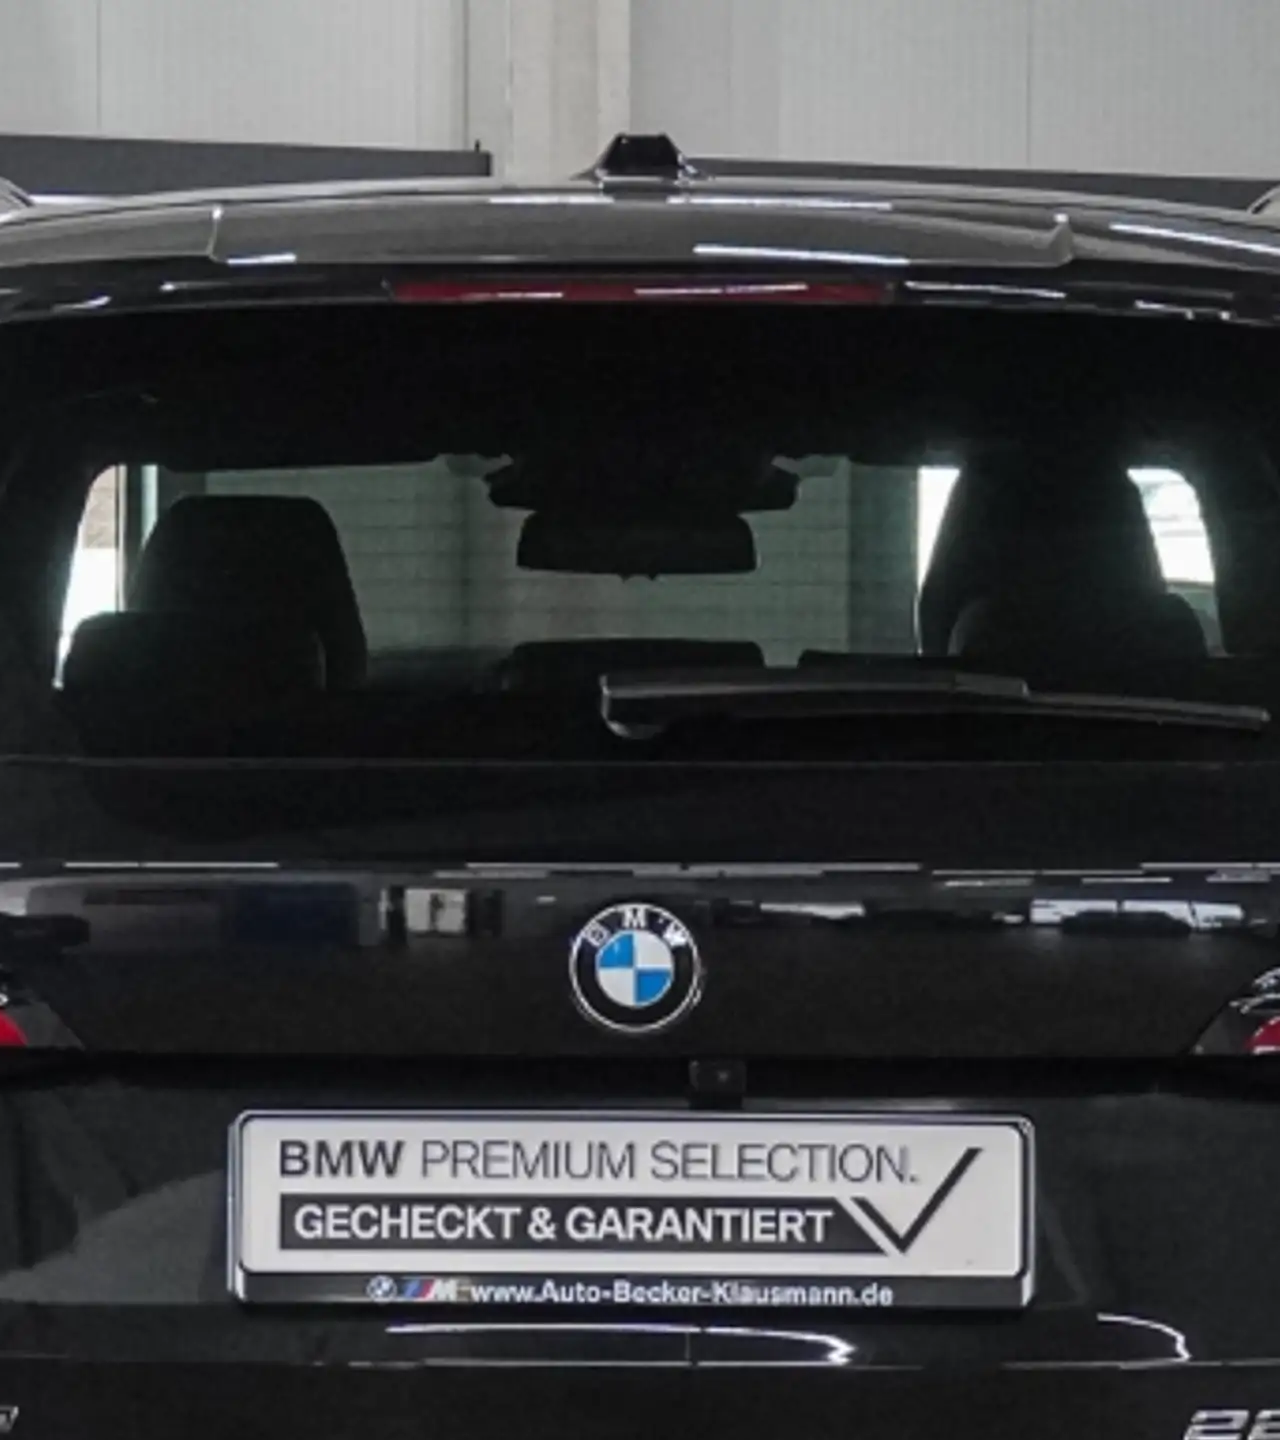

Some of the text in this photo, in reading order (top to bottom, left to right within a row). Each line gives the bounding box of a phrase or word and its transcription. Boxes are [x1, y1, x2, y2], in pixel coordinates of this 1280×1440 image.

[584, 905, 688, 947] BMW
[279, 1139, 919, 1183] BMW PREMIUM SELECTION.
[294, 1205, 833, 1243] GECHECKT & GARANTIERT
[470, 1280, 894, 1307] www.Auto-Becker-Klausmann.de
